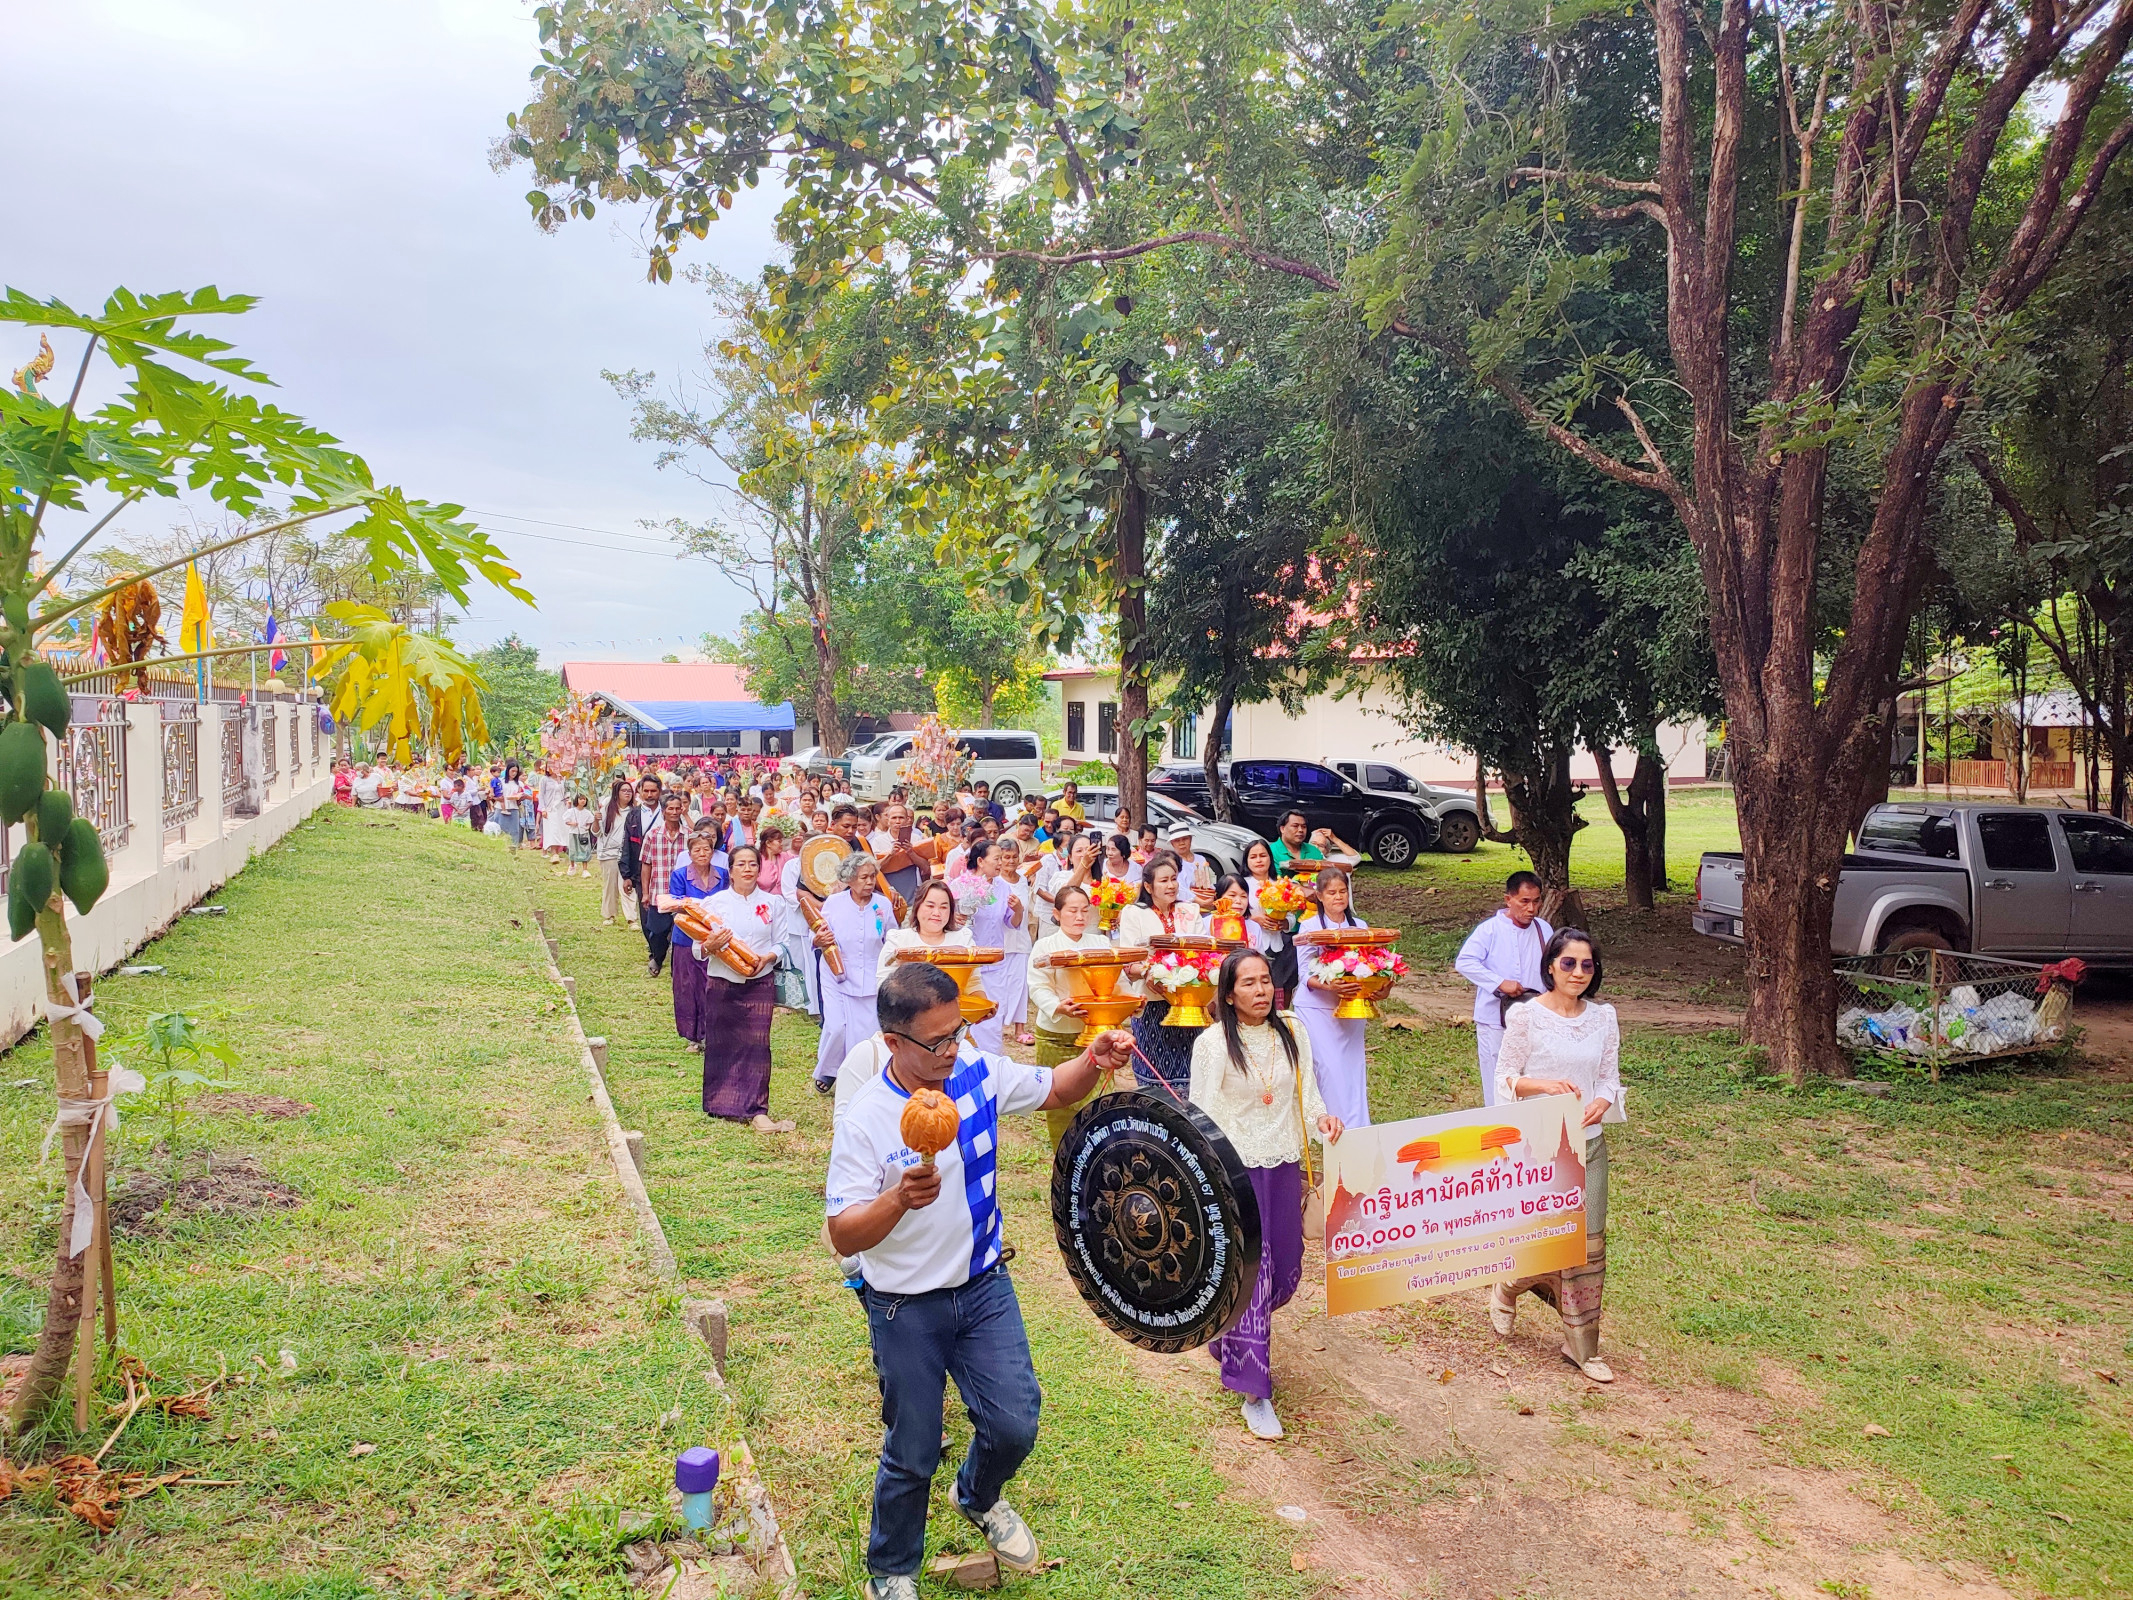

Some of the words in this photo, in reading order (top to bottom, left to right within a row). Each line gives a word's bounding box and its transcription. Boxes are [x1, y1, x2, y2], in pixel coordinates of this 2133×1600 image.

[1170, 1137, 1178, 1147] 2
[1201, 1184, 1215, 1196] 67
[1363, 1161, 1553, 1220] กฐินสามัคคีทั่วไทย
[1334, 1223, 1416, 1251] ๓๐,๐๐๐
[1422, 1219, 1439, 1235] วัด
[1443, 1207, 1515, 1237] พุทธศักราช
[1520, 1189, 1579, 1215] ๒๕๖๘
[1337, 1265, 1356, 1278] โดย
[1359, 1251, 1434, 1275] คณะศิษยานุศิษย์
[1437, 1242, 1480, 1263] บูชาธรรม
[1499, 1235, 1506, 1248] ปี
[1407, 1258, 1516, 1291] (จังหวัดอุบลราชธานี)
